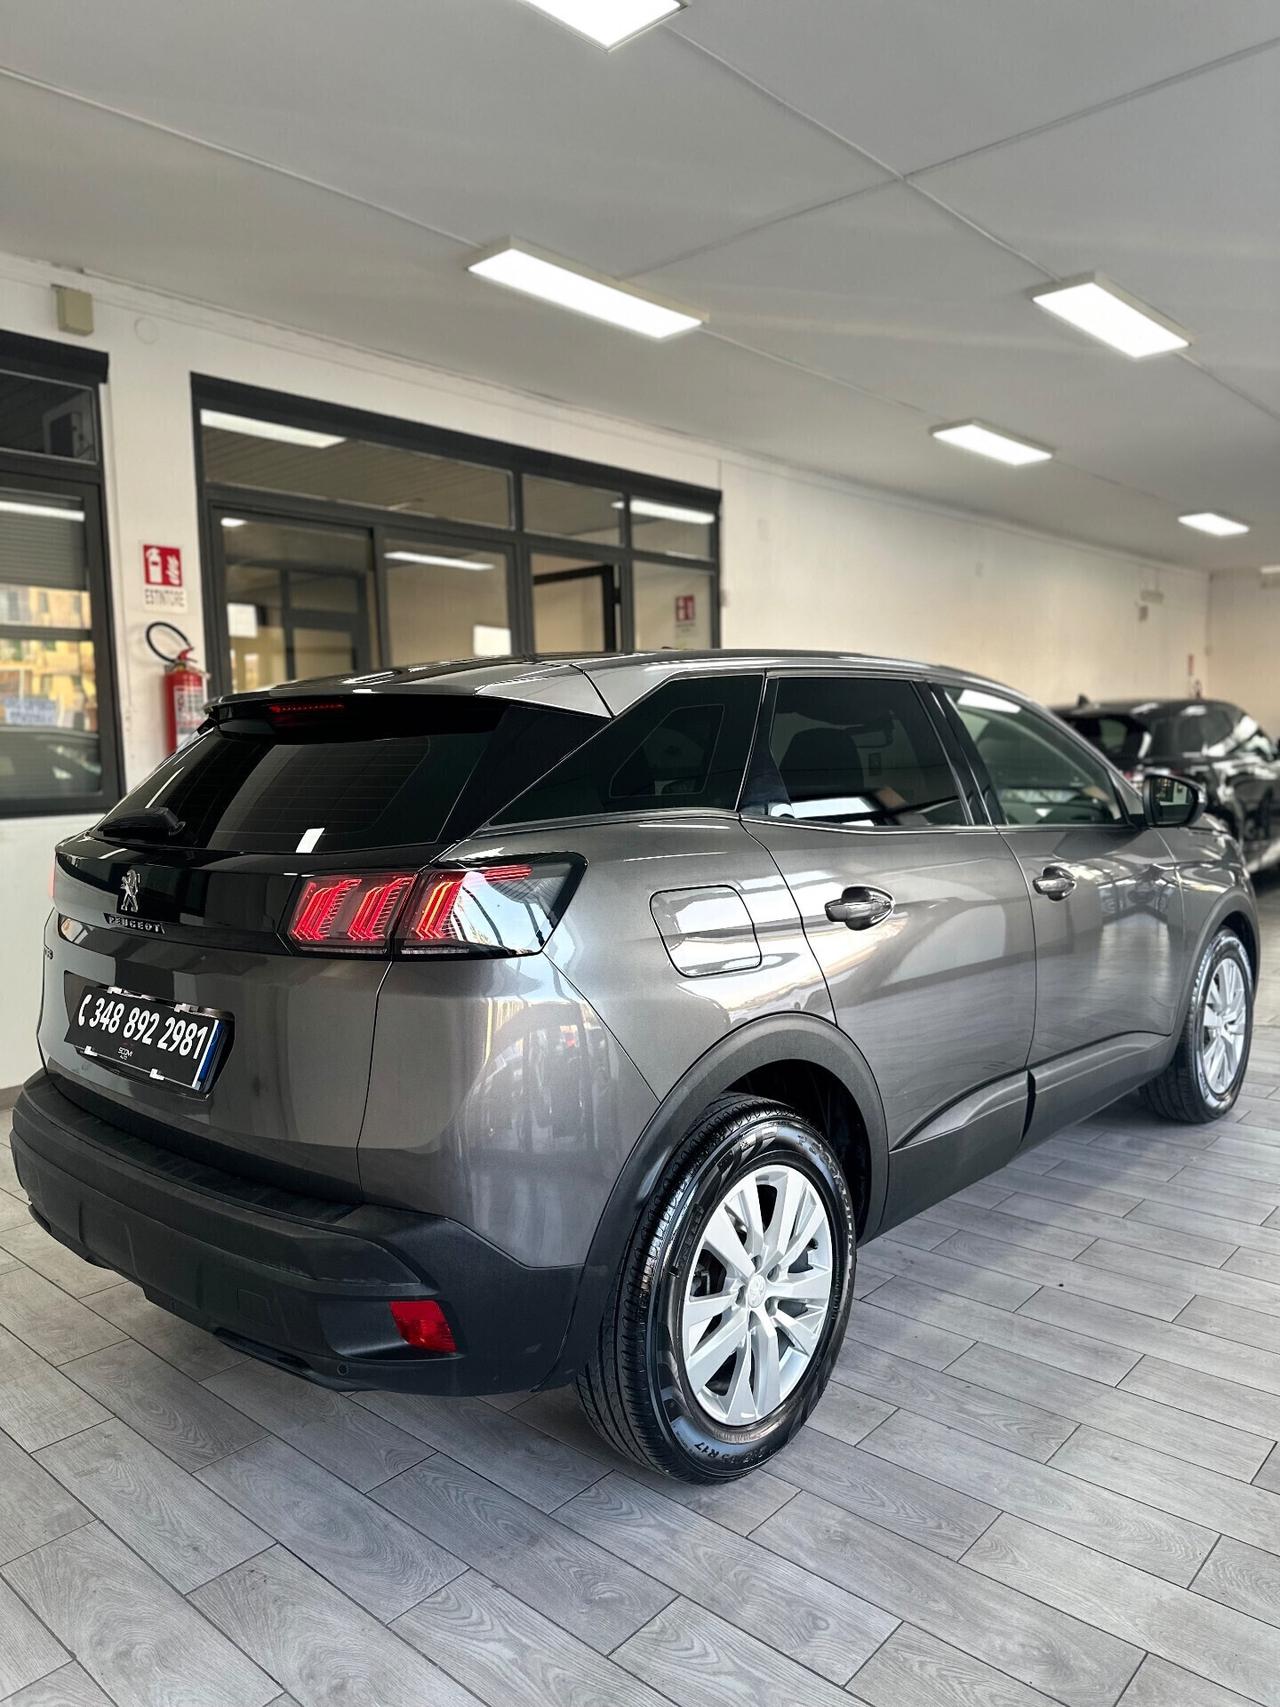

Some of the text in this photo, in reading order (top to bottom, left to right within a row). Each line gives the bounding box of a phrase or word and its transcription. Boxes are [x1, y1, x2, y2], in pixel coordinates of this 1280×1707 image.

[108, 915, 161, 933] PEUGEOT
[88, 997, 209, 1060] 348 892 2981
[694, 1442, 719, 1459] R17
